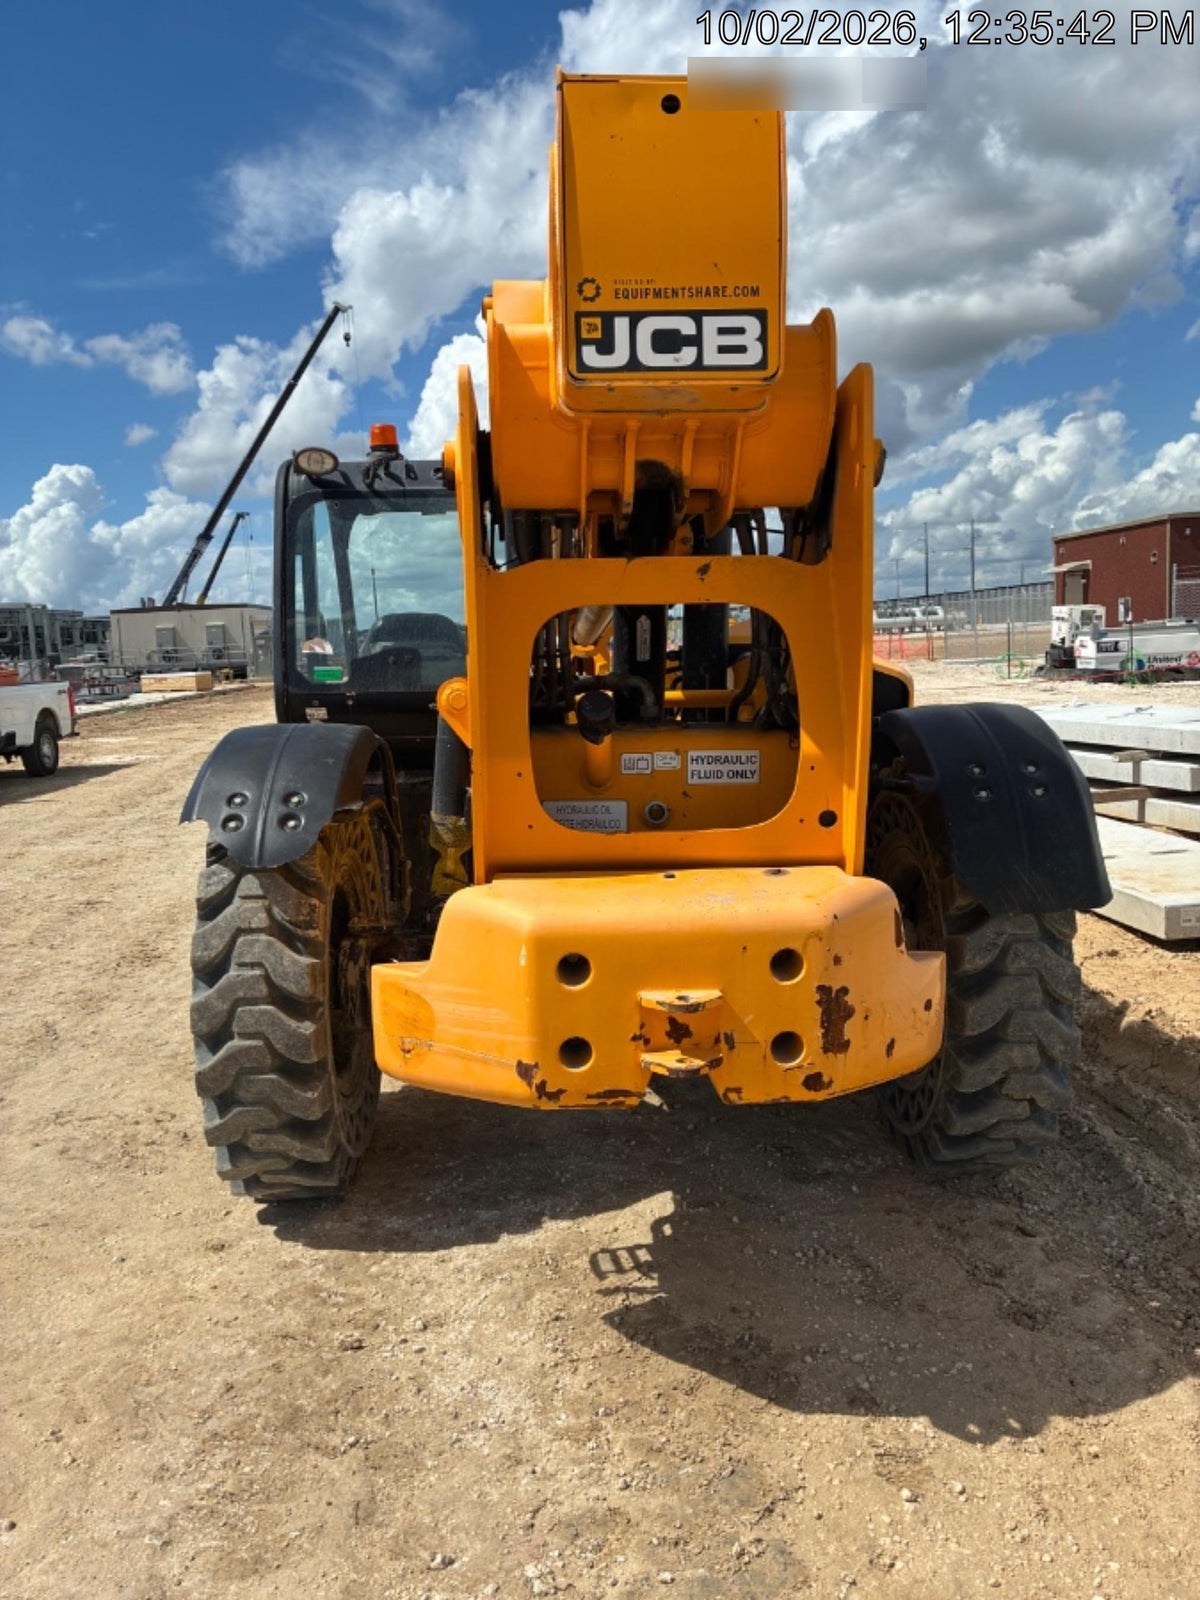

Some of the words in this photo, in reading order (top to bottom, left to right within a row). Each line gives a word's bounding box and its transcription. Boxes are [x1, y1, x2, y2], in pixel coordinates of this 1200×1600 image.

[614, 285, 760, 300] EQUIPMENTSHARE.COM
[581, 316, 763, 368] JCB
[1147, 654, 1182, 664] United
[690, 755, 758, 765] HYDRAULIC
[690, 769, 723, 780] FLUID
[726, 769, 757, 780] ONLY
